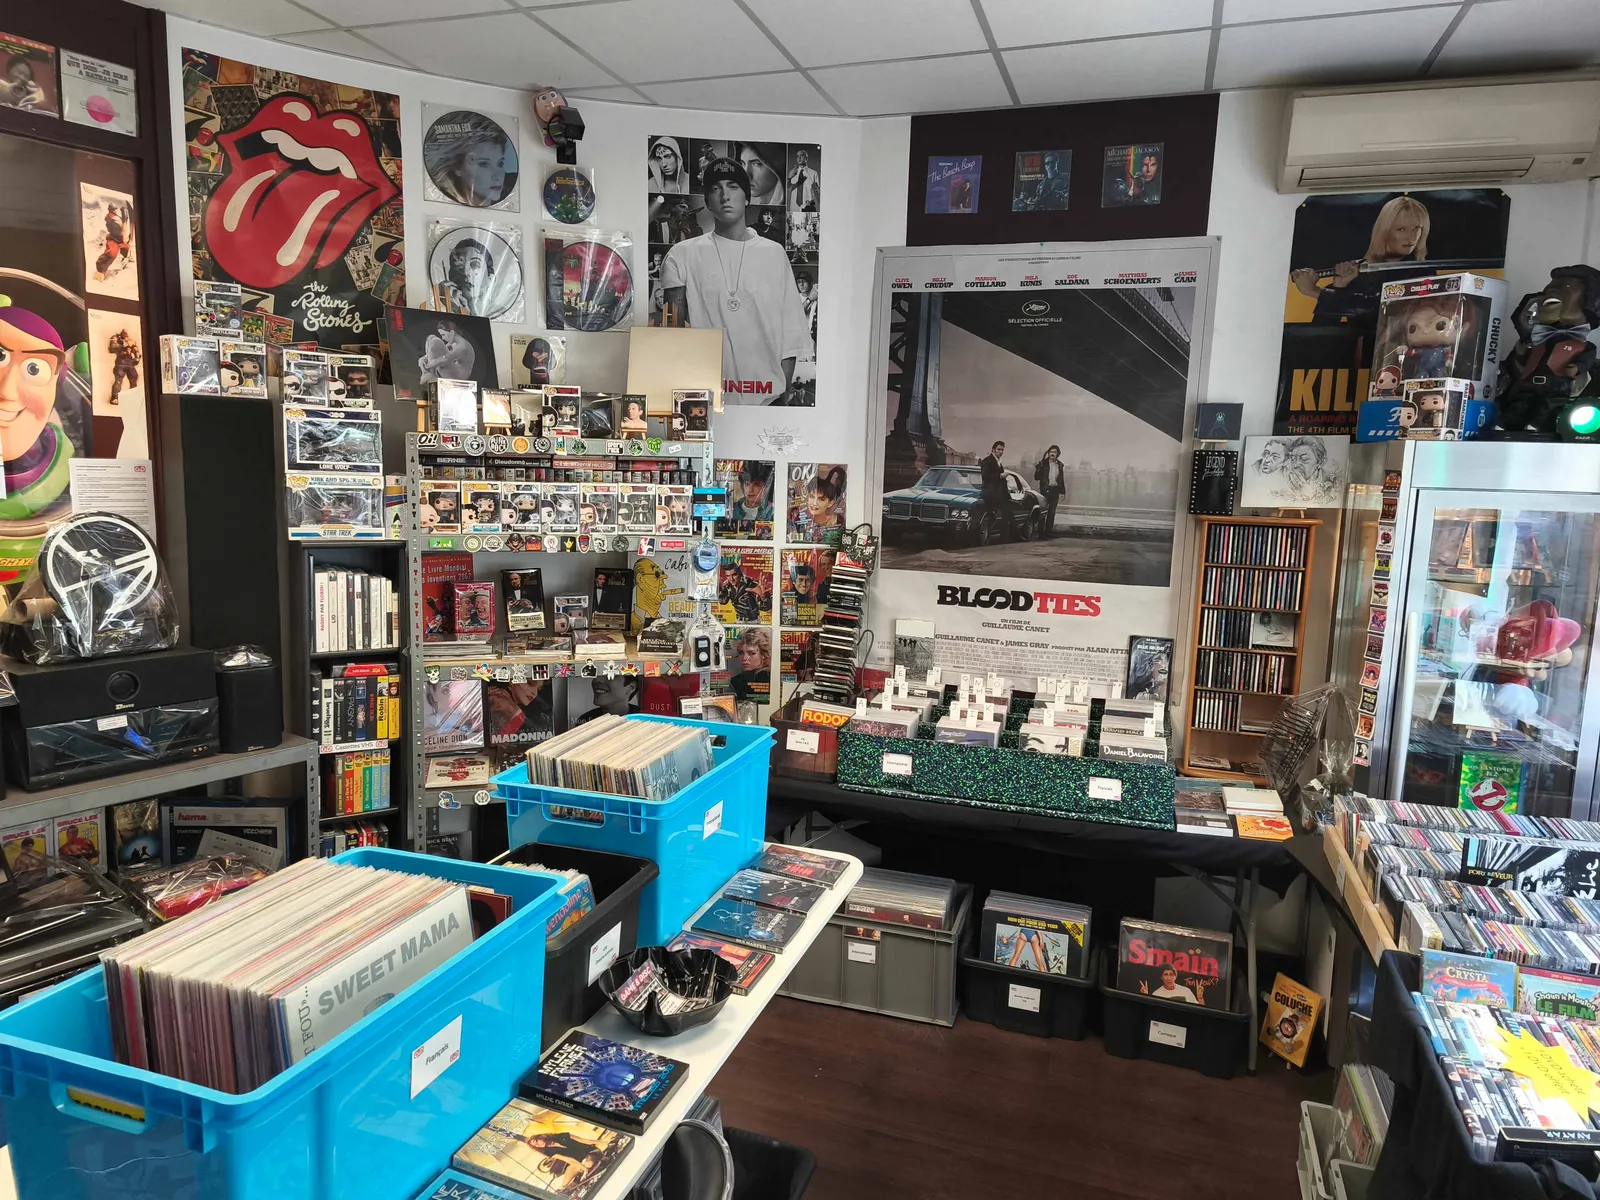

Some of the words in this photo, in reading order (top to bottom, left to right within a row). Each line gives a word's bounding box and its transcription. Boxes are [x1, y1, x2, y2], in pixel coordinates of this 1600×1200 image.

[434, 123, 461, 134] SAMANTHA
[461, 122, 472, 132] FOX
[942, 162, 960, 178] Beach
[961, 158, 976, 172] Boys
[303, 281, 328, 292] the
[1104, 277, 1161, 285] SCHOENAERTS
[1427, 283, 1440, 291] PLAY
[291, 292, 355, 317] Rolling
[303, 308, 372, 333] Stones
[1488, 317, 1501, 364] CHUCKY
[1300, 415, 1346, 423] ROARING
[418, 434, 438, 444] Oi!
[716, 460, 744, 472] salut!
[1205, 456, 1225, 467] LEGEND
[427, 565, 443, 573] Livre
[444, 564, 467, 572] Mondial
[427, 574, 456, 583] Inventions
[669, 602, 696, 612] BEAUF
[937, 585, 1033, 611] BLOOD
[1033, 591, 1101, 617] TIES
[982, 622, 1024, 631] GUILLAUME
[935, 634, 975, 642] GUILLAUME
[1005, 640, 1028, 648] JAMES
[1086, 646, 1109, 654] ALAIN
[650, 703, 671, 711] DUST
[424, 735, 449, 745] CÉLINE
[451, 734, 468, 743] DION
[491, 731, 553, 744] MADONNA
[335, 743, 360, 751] Cassettes
[1103, 745, 1127, 757] DANIEL
[1127, 748, 1165, 760] BALAVOINE
[57, 817, 84, 828] BRUCE
[84, 814, 98, 822] LEE
[178, 813, 207, 822] hama
[2, 831, 30, 841] BRUCE
[31, 827, 46, 835] LEE
[546, 889, 582, 936] wendoline
[318, 949, 396, 1016] SWEET
[401, 912, 459, 964] MAMA
[1128, 939, 1219, 977] Smaïn
[1446, 966, 1489, 983] CRYSTA
[620, 983, 636, 1001] GAME
[639, 966, 652, 983] DISC
[1275, 991, 1313, 1017] COLUCHE
[1534, 991, 1560, 1000] Shaun
[1568, 992, 1596, 1011] Mouton
[1536, 999, 1553, 1012] LE
[1558, 1003, 1596, 1021] FILM
[425, 1043, 449, 1066] Français
[538, 1043, 574, 1074] MYLENE
[549, 1045, 587, 1078] FARMER
[1543, 1130, 1591, 1140] AVATAR
